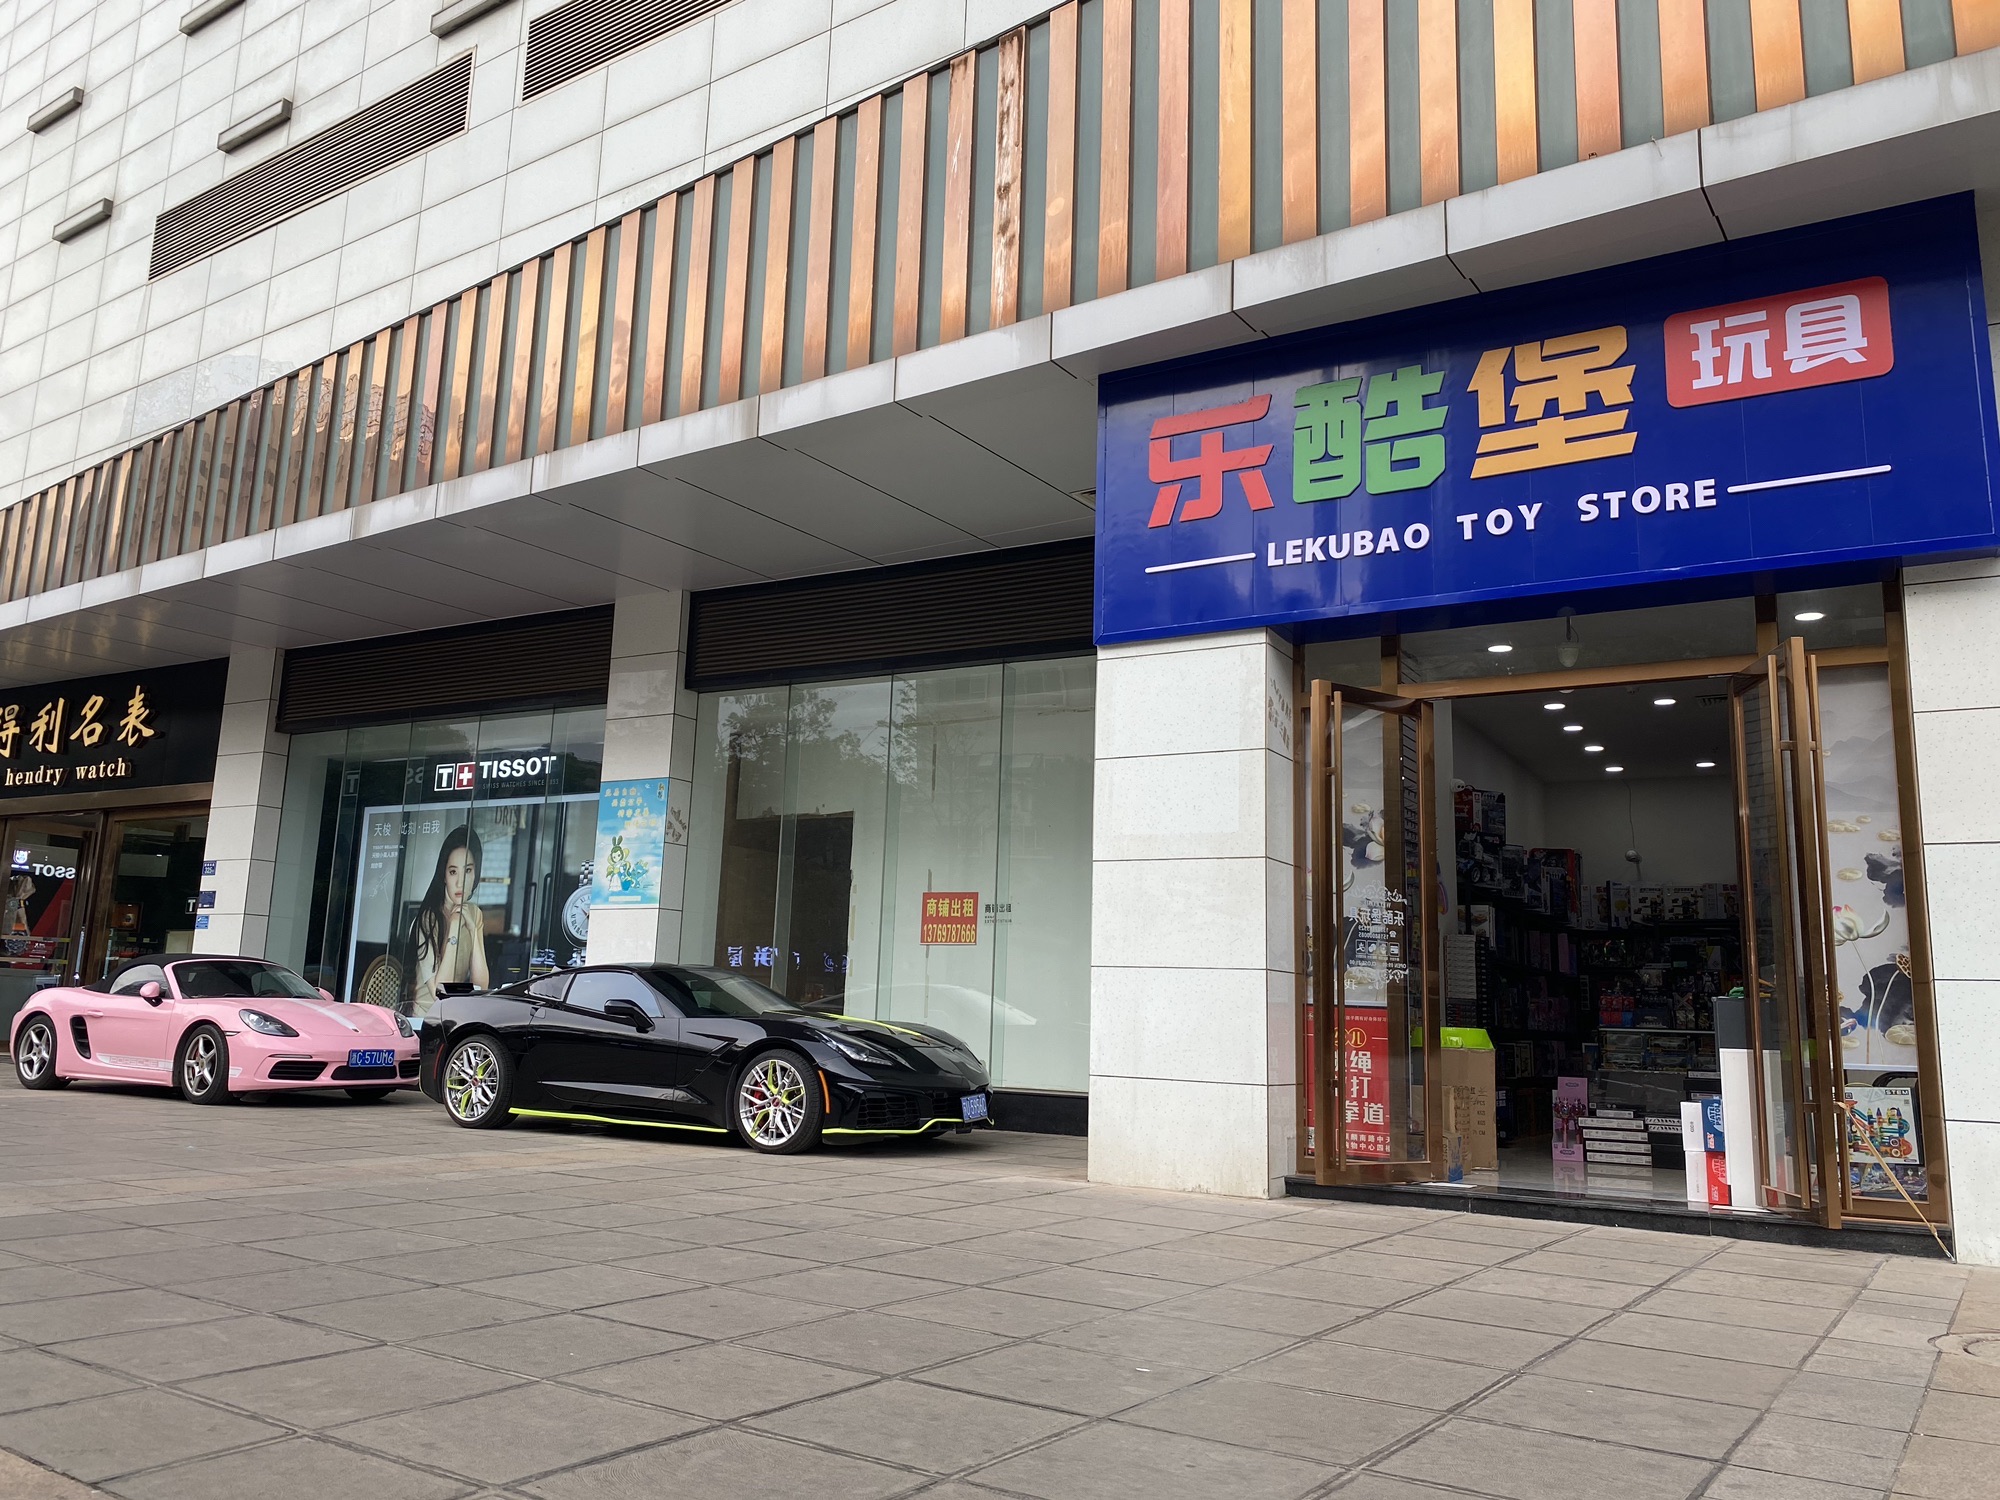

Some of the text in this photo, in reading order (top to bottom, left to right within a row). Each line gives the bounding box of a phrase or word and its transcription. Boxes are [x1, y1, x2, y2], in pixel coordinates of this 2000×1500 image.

[1690, 294, 1869, 391] 玩具
[1146, 325, 1638, 529] 乐酷堡
[1267, 478, 1718, 568] LEKUBAO TOY STORE
[4, 757, 127, 787] hendry watch
[479, 755, 557, 779] TISSOT
[501, 780, 526, 788] WATCHES
[528, 778, 545, 787] SINCE
[373, 822, 392, 836] 天梭
[926, 898, 974, 917] 商铺出租
[923, 923, 976, 943] 13769787666
[110, 1057, 158, 1067] PORSCHE
